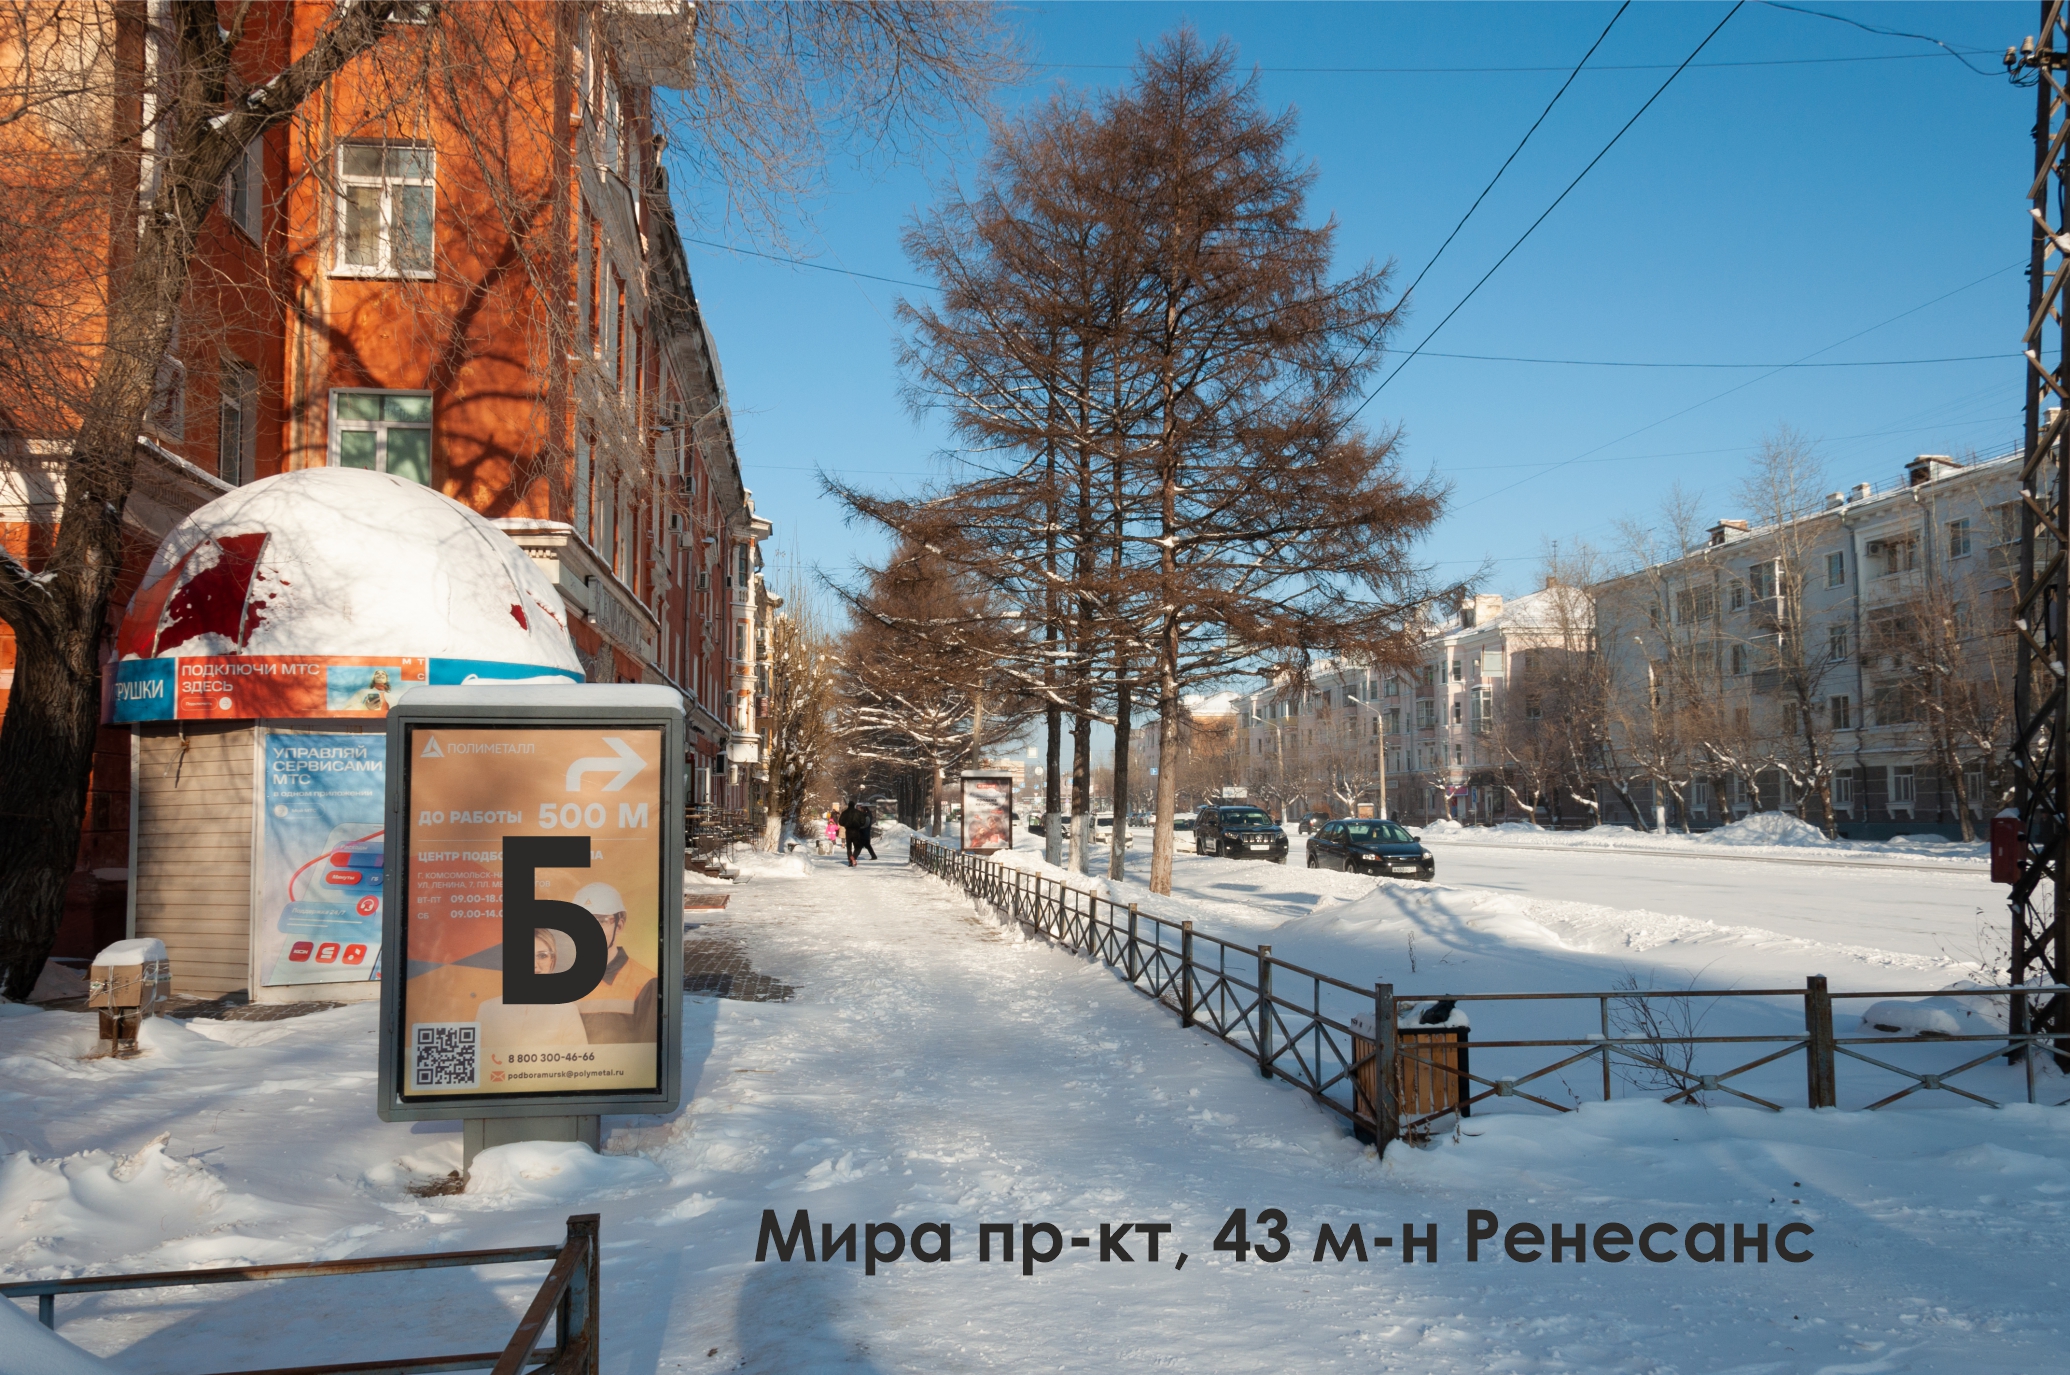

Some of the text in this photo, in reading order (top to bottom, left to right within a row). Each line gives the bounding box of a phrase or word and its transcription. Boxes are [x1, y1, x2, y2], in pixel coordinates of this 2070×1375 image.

[181, 663, 320, 677] ПОДКЛЮЧИ МТС
[181, 680, 234, 694] ЗДЕСЬ
[273, 745, 367, 759] УПРАВЛЯЙ
[447, 743, 535, 754] ПОЛИМЕТАЛЛ
[272, 760, 383, 772] СЕРВИСАМИ
[272, 773, 311, 785] МТС
[313, 790, 373, 798] приложении
[418, 802, 649, 829] ДО РАБОТЫ 500 М
[417, 851, 503, 863] ЦЕНТР ПОДБО
[432, 881, 468, 889] ЛЕНИНА,
[417, 896, 442, 904] ВТ-ПТ
[417, 912, 430, 920] СБ
[508, 1052, 595, 1063] 8 800 300-46-66
[507, 1069, 625, 1081] podboramursk@polymetal.ru
